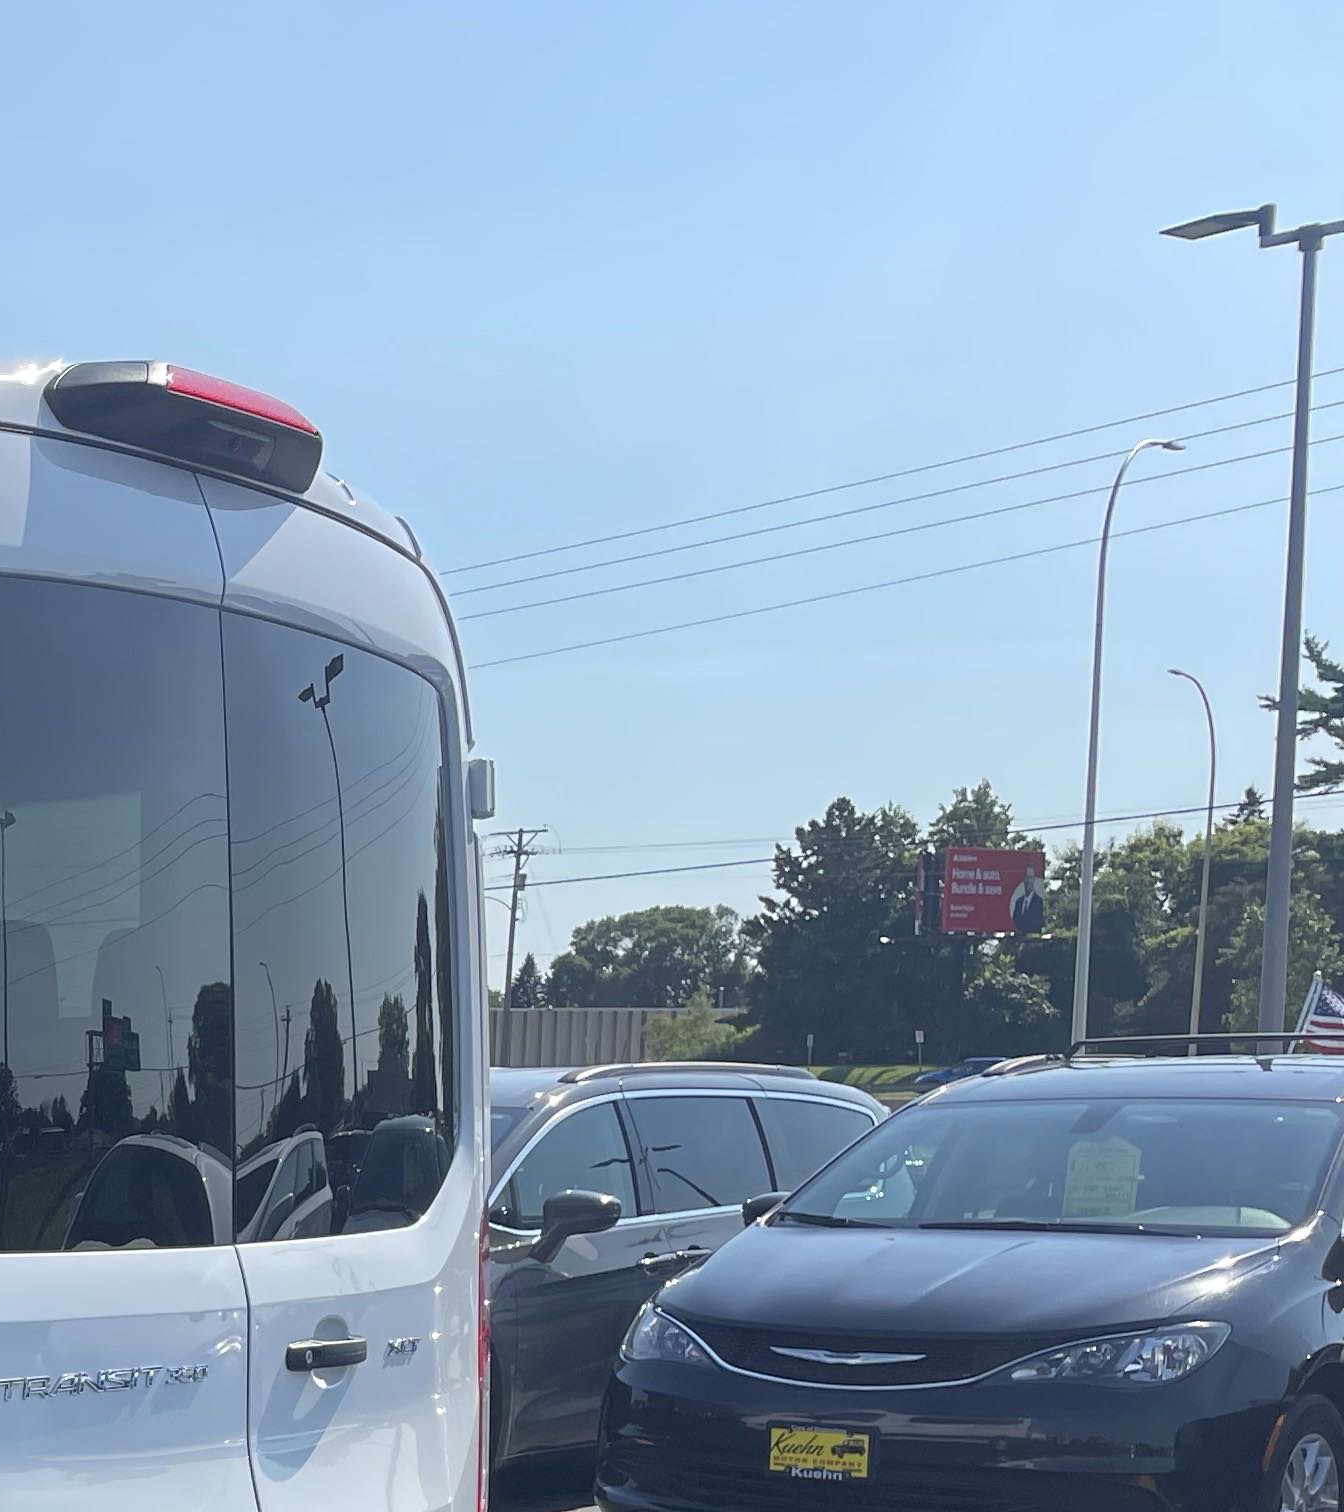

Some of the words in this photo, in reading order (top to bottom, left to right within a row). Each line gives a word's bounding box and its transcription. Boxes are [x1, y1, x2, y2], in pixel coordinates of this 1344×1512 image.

[165, 1364, 209, 1385] 350
[770, 1431, 824, 1456] Kuehn
[791, 1467, 843, 1480] Kuehn
